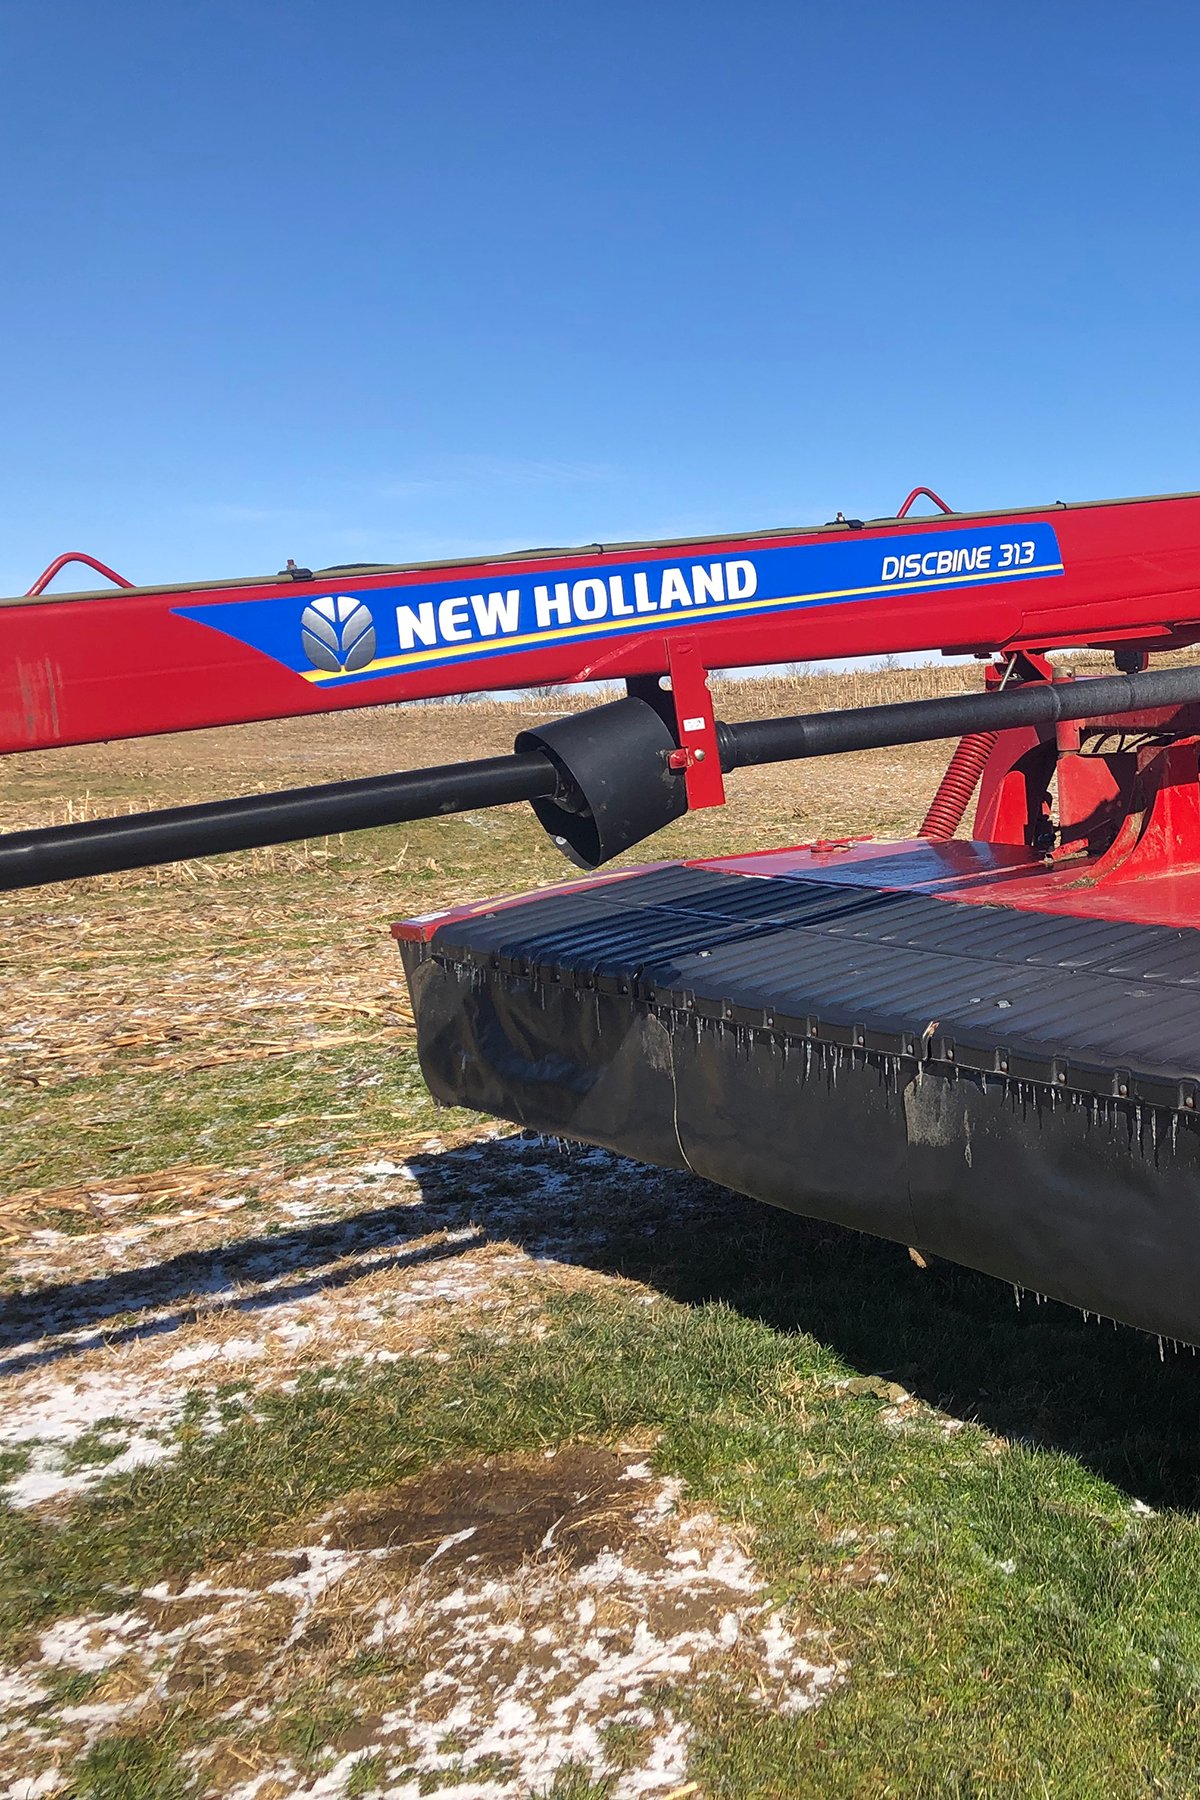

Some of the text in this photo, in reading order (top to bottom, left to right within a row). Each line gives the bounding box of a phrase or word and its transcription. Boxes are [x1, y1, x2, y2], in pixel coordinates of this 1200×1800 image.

[881, 541, 1036, 581] DISCBINE 313
[395, 559, 758, 650] NEW HOLLAND
